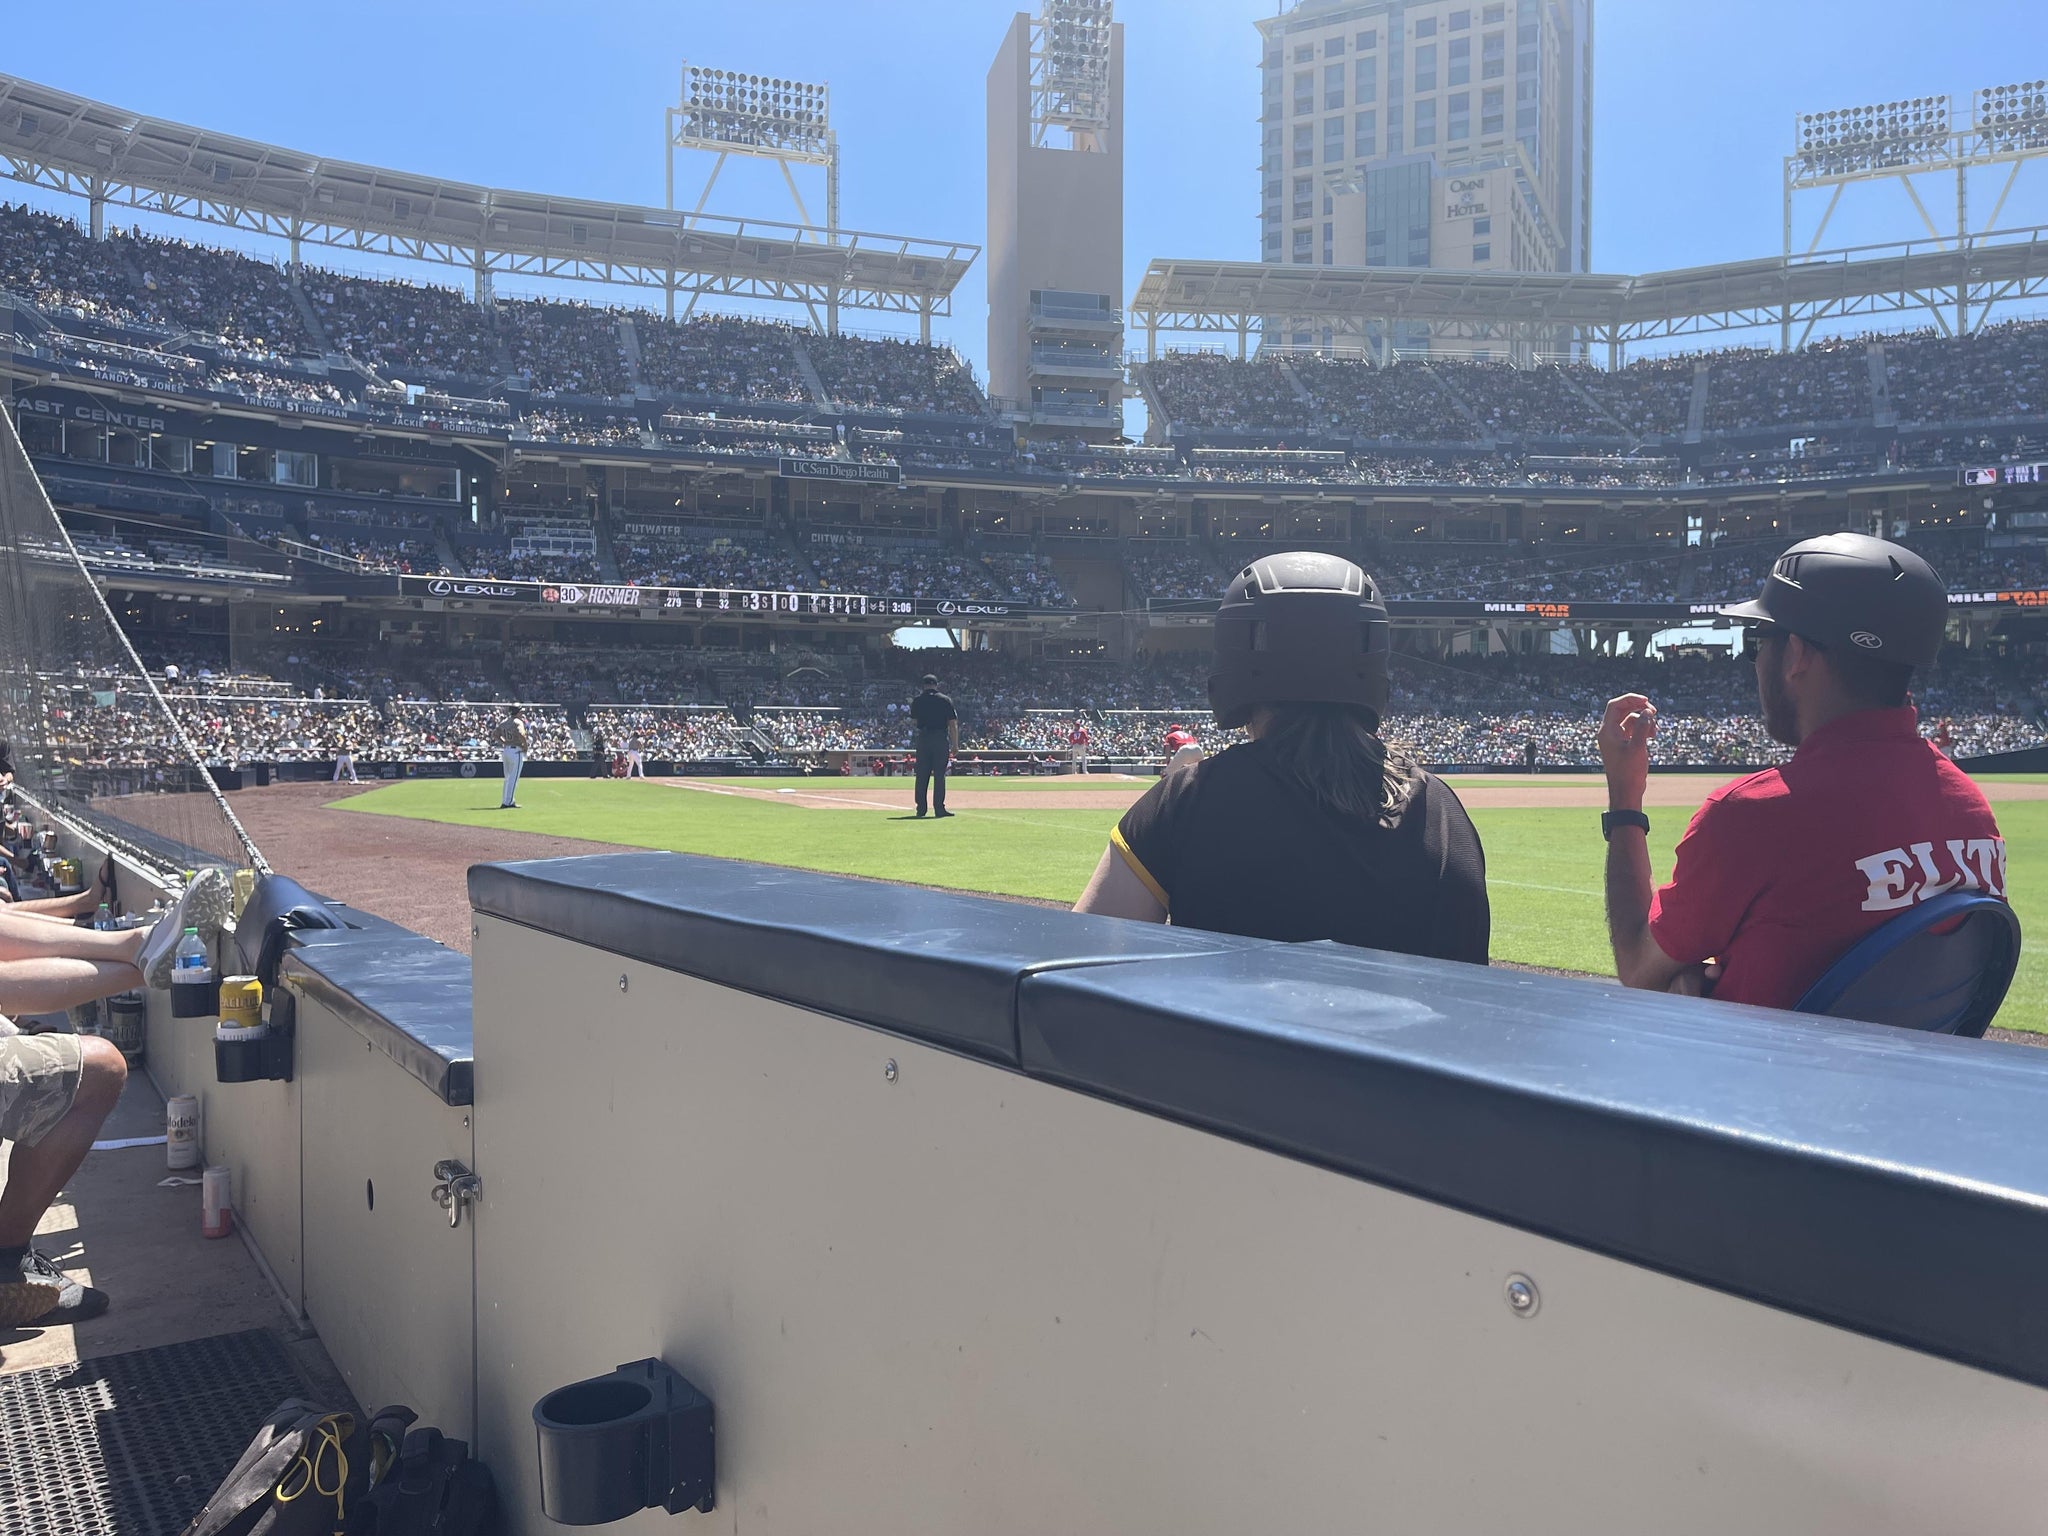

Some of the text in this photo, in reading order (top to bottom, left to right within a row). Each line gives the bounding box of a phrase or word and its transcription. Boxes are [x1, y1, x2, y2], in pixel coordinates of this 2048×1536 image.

[1447, 203, 1488, 218] HOTEL
[94, 372, 184, 394] RANDY 35 JONES
[244, 397, 348, 419] TREVOR 51 HOFFMAN
[75, 406, 165, 430] CENTER
[392, 418, 424, 428] JACKIE
[443, 423, 489, 435] ROBINSON
[793, 462, 889, 479] UC San Diego Health
[453, 584, 517, 597] LEXUS
[561, 587, 640, 605] 30 HOSMER
[664, 598, 729, 609] .279 6 32
[742, 595, 749, 608] B
[750, 593, 760, 610] 3
[761, 596, 768, 608] S
[771, 593, 777, 611] 1
[892, 602, 912, 613] 3:06
[958, 605, 1009, 614] LEXUS
[1484, 603, 1569, 612] MILESTAR
